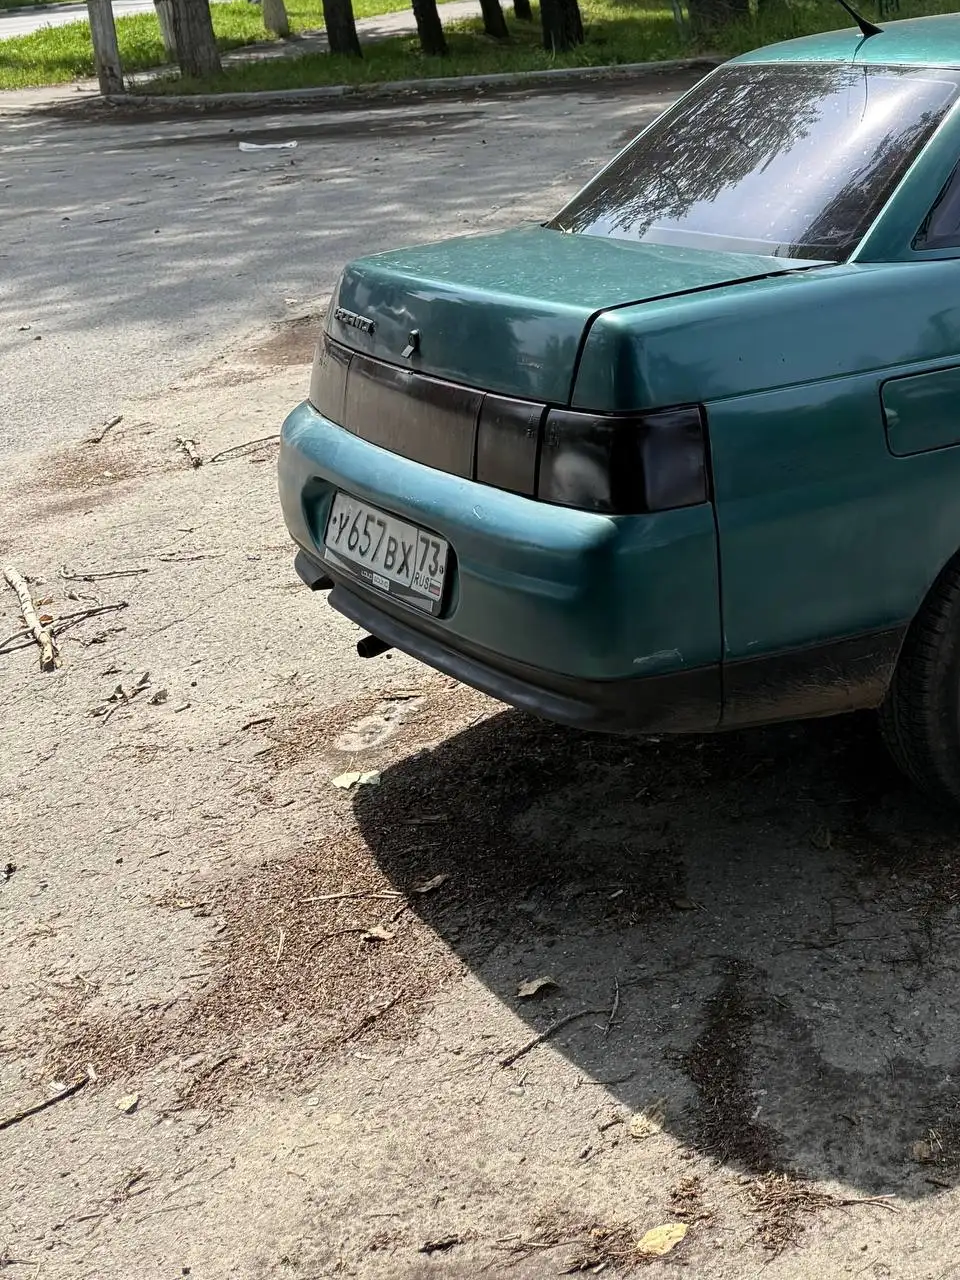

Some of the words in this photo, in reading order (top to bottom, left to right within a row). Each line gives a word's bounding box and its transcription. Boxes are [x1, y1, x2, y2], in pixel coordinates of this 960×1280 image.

[335, 510, 413, 579] У657ВХ
[420, 536, 441, 577] 73
[414, 572, 430, 590] RUS
